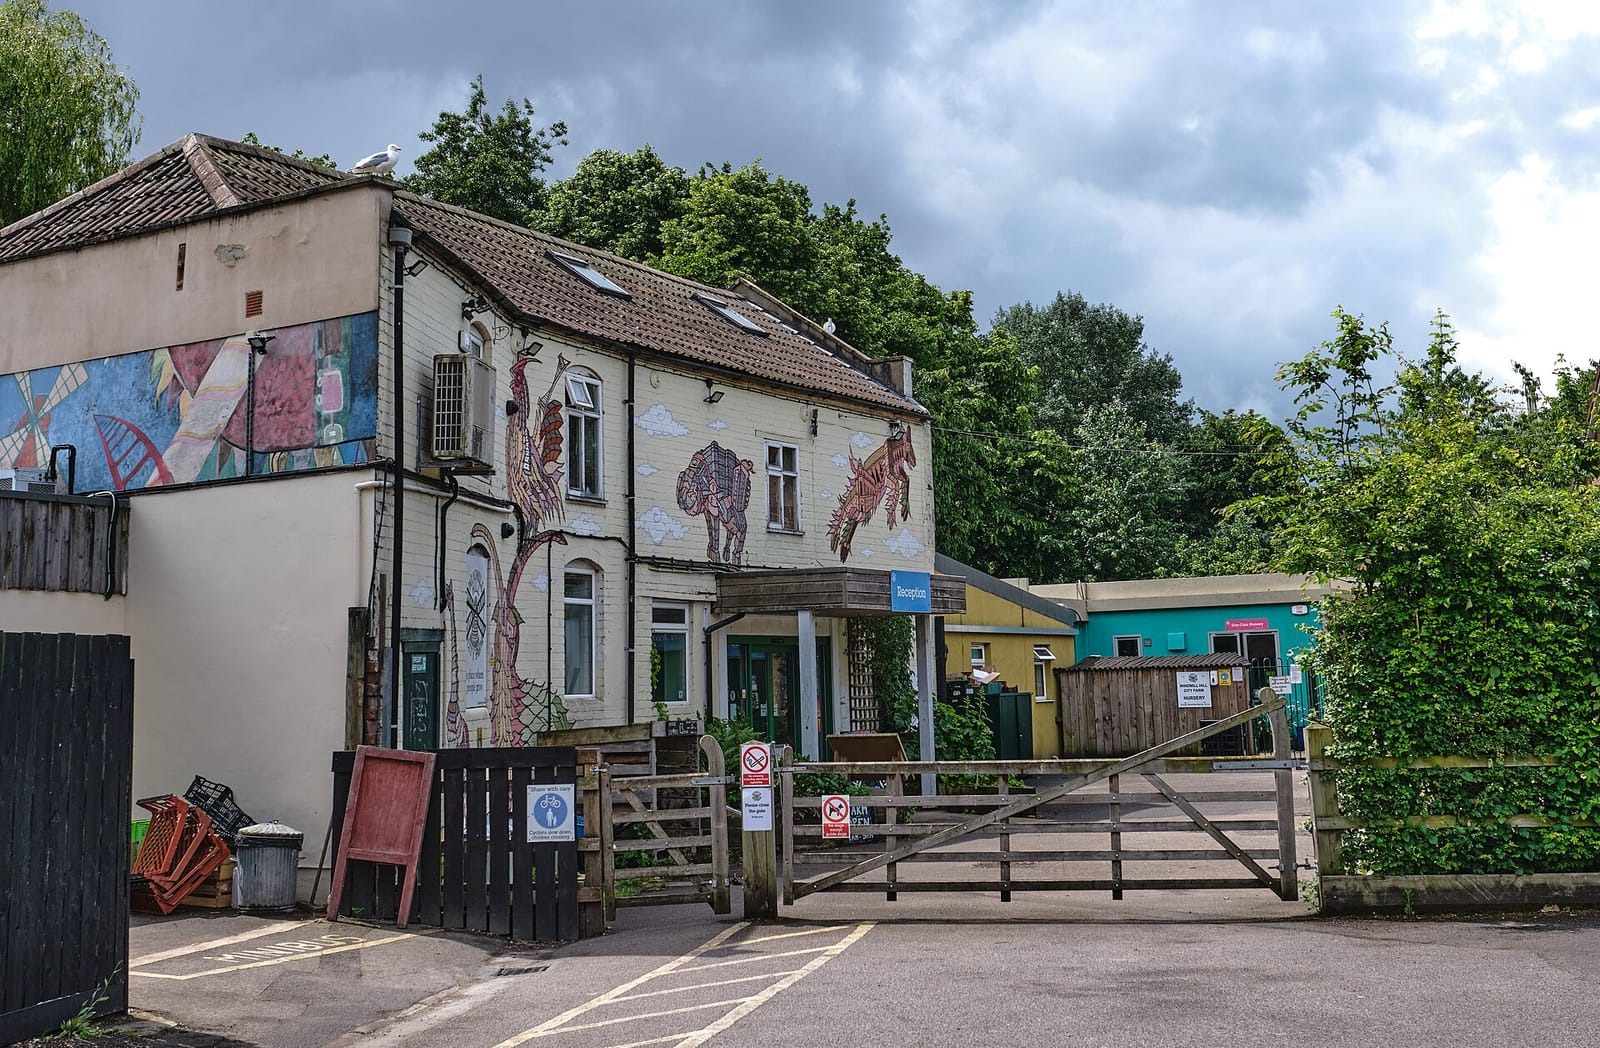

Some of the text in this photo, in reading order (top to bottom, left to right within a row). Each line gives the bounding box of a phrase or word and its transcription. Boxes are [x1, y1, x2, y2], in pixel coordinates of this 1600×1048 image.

[896, 585, 927, 600] Reception
[850, 806, 868, 816] ARM
[203, 934, 368, 963] MINIBUS
